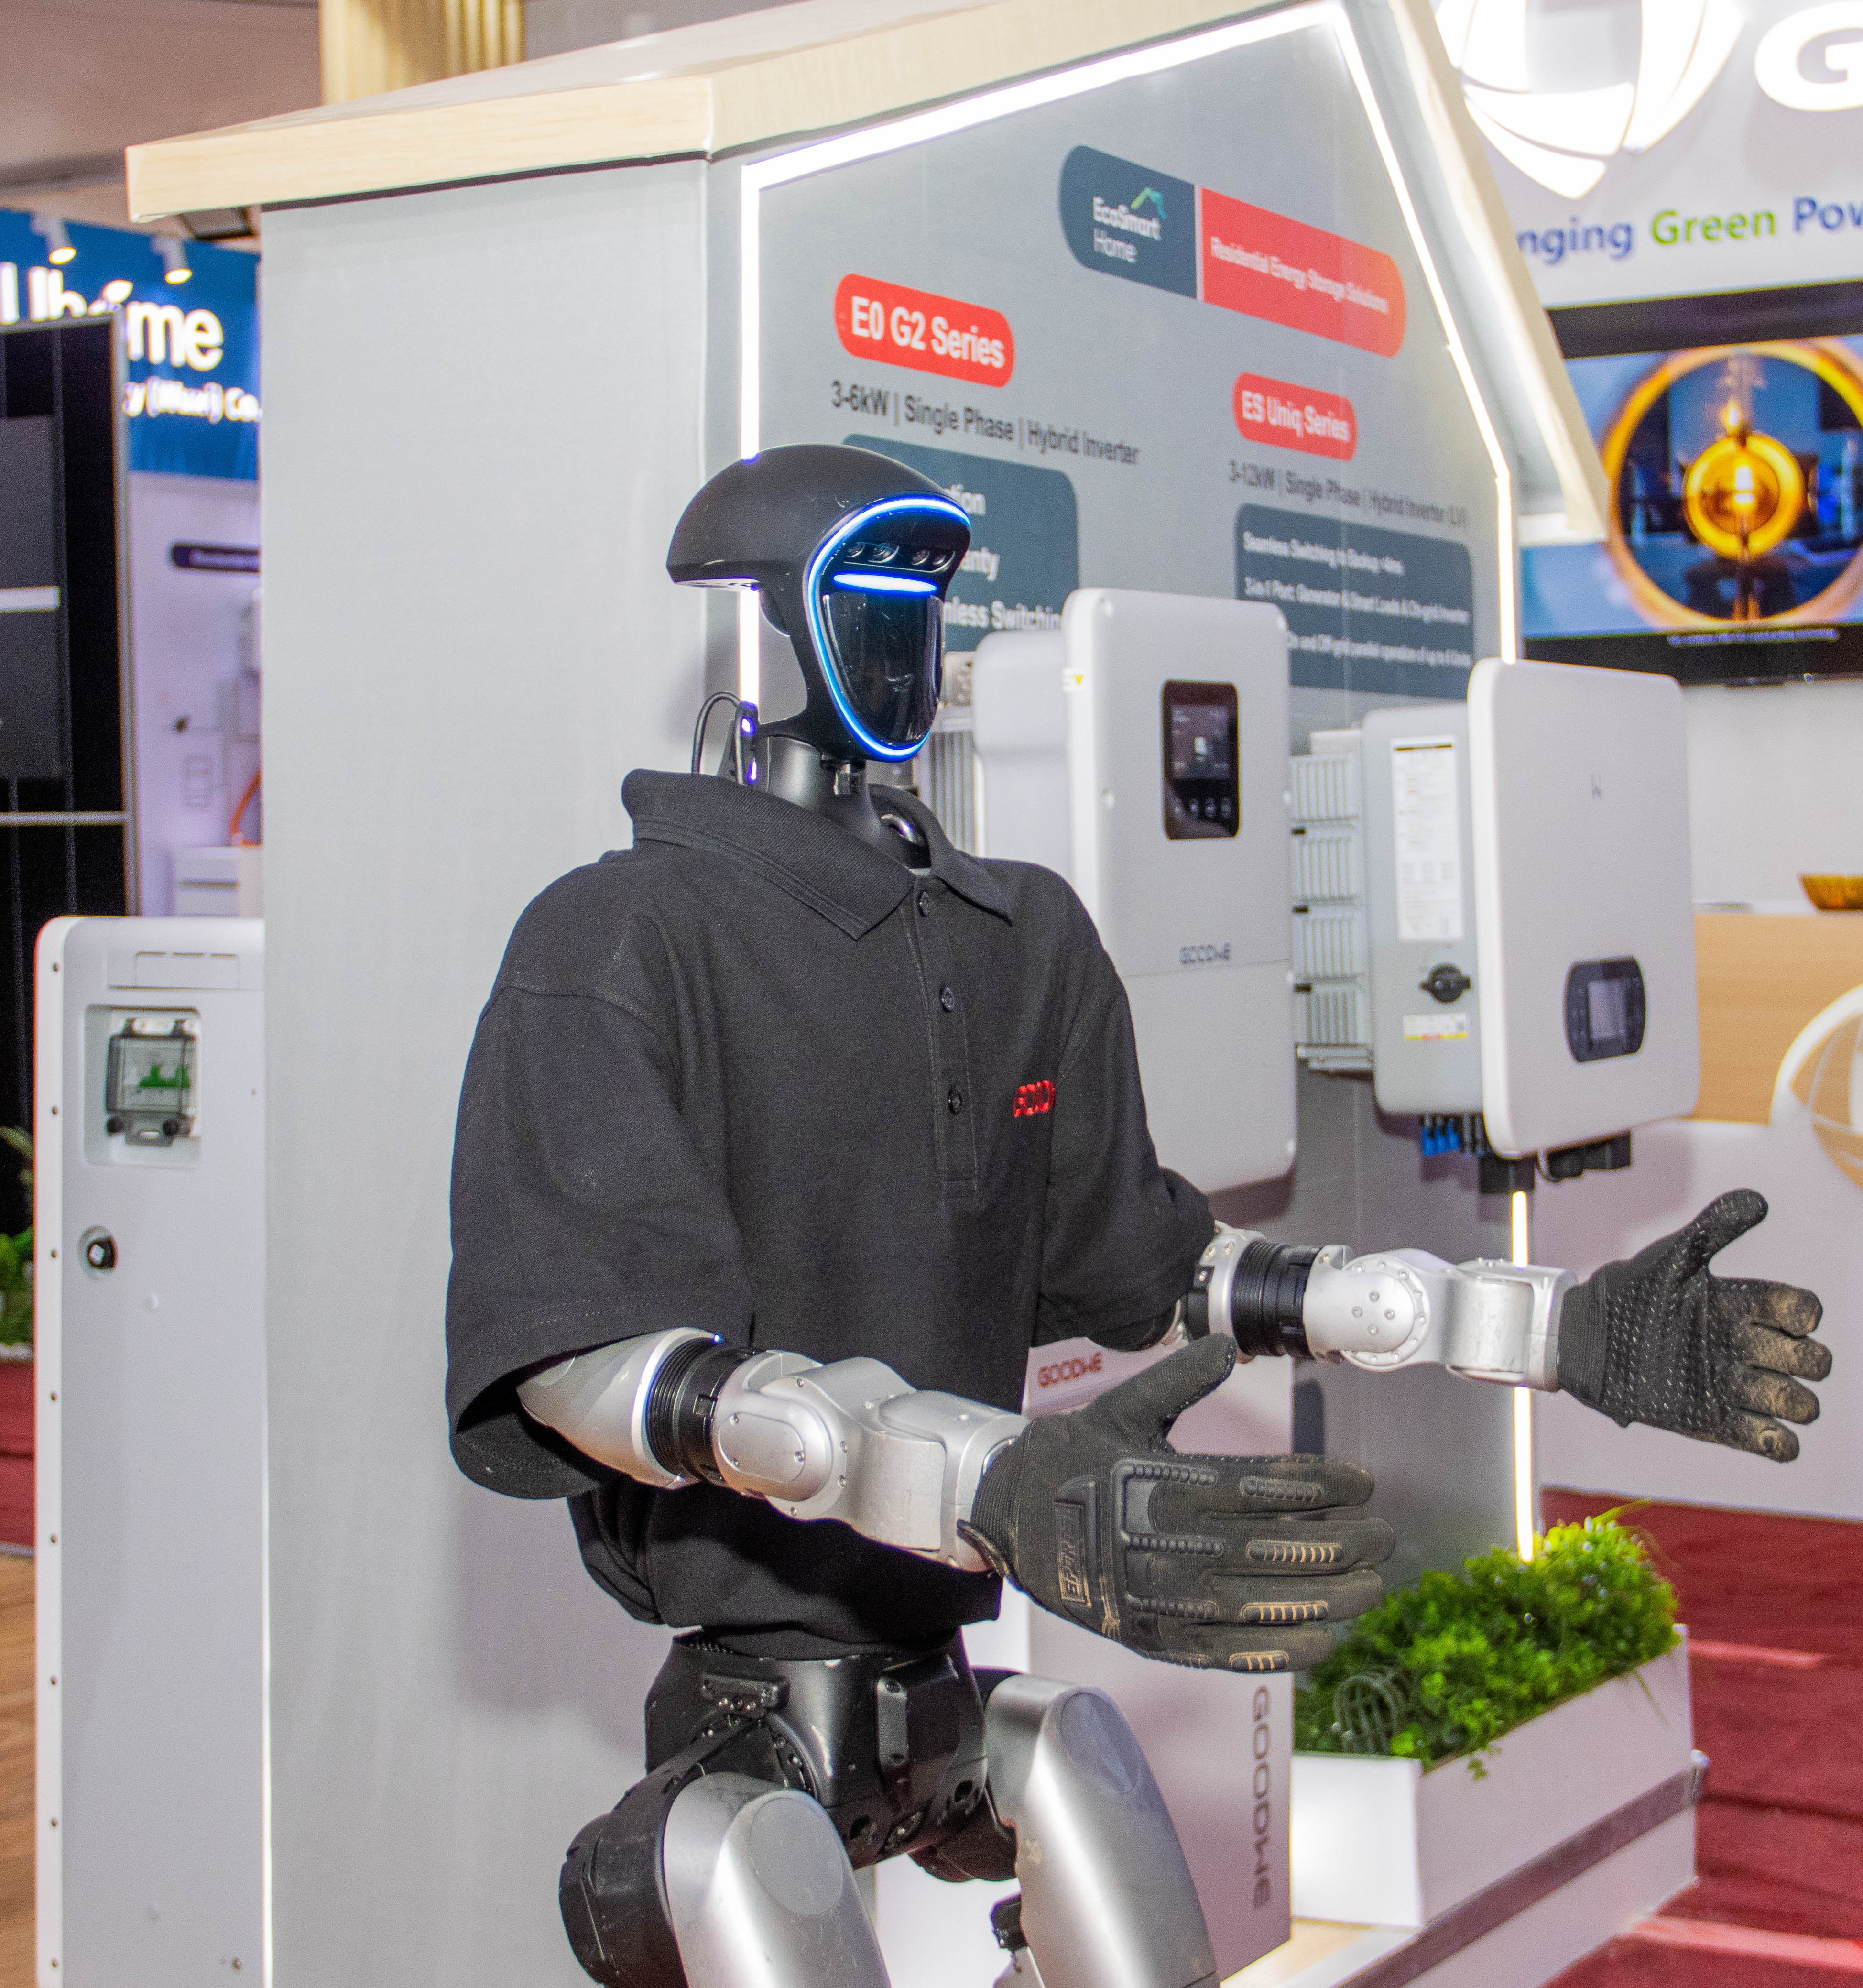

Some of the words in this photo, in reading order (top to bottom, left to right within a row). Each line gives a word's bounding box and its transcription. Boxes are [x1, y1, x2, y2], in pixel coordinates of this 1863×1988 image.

[1093, 197, 1161, 240] EcoSmart
[1651, 210, 1777, 246] Green
[1094, 229, 1137, 263] Home
[1211, 237, 1270, 274] Residential
[1271, 257, 1306, 291] Energy
[1308, 269, 1344, 302] Storage
[1347, 282, 1389, 314] Solutions
[891, 306, 926, 350] G2
[931, 316, 1005, 369] Series
[831, 381, 889, 417] 3-6kW
[904, 394, 958, 435] Single
[964, 407, 1014, 442] Phase
[1028, 420, 1079, 454] Hybrid
[1082, 432, 1140, 465] Inverter
[1242, 391, 1264, 423] ES
[1267, 398, 1303, 438] Uniq
[1304, 406, 1351, 442] Series
[1285, 470, 1323, 503] Single
[1327, 479, 1361, 507] Phase
